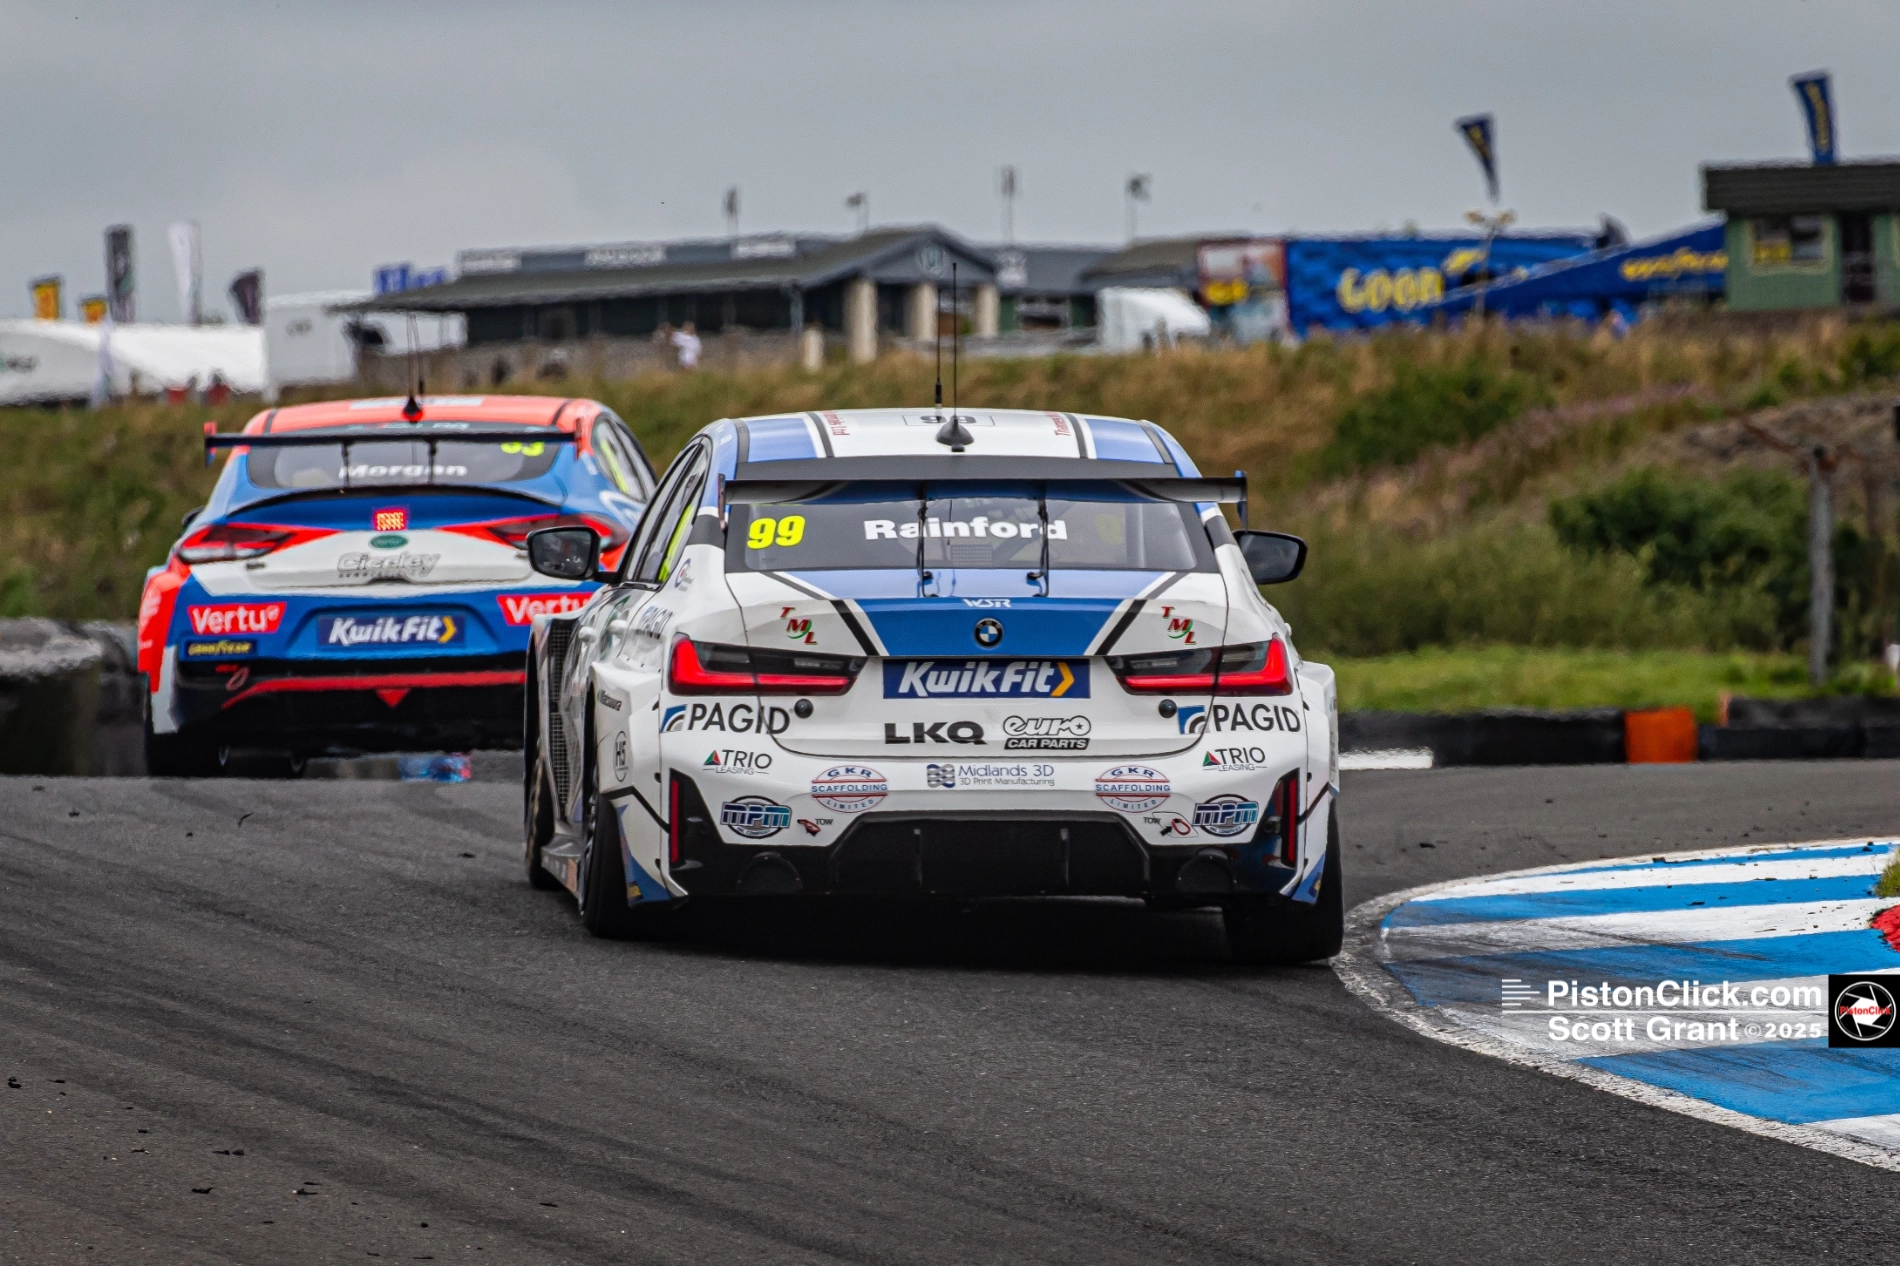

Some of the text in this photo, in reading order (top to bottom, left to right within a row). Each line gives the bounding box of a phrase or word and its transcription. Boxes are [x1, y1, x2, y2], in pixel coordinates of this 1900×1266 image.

[339, 463, 468, 479] Morgan
[747, 515, 806, 549] 99
[863, 516, 1068, 540] Rainford
[962, 598, 1012, 608] WSR
[192, 605, 268, 634] Vertu
[688, 702, 791, 735] PAGID
[1213, 702, 1302, 733] PAGID
[884, 720, 988, 746] LKQ
[1008, 738, 1087, 749] CAR PARTS
[722, 749, 773, 770] TRIO
[1215, 747, 1266, 765] TRIO
[715, 766, 754, 777] LEASING
[827, 766, 873, 779] GKR
[958, 764, 1055, 777] Midlands 3D
[1111, 766, 1155, 778] GKR
[1218, 763, 1255, 772] LEASING
[960, 776, 1056, 787] 3D Print Manufacturing
[811, 784, 888, 793] SCAFFOLDING
[1095, 784, 1171, 793] SCAFFOLDING
[826, 799, 874, 810] LIMITED
[1110, 799, 1157, 810] LIMITED
[815, 818, 834, 826] TOW
[1143, 816, 1161, 825] TOW
